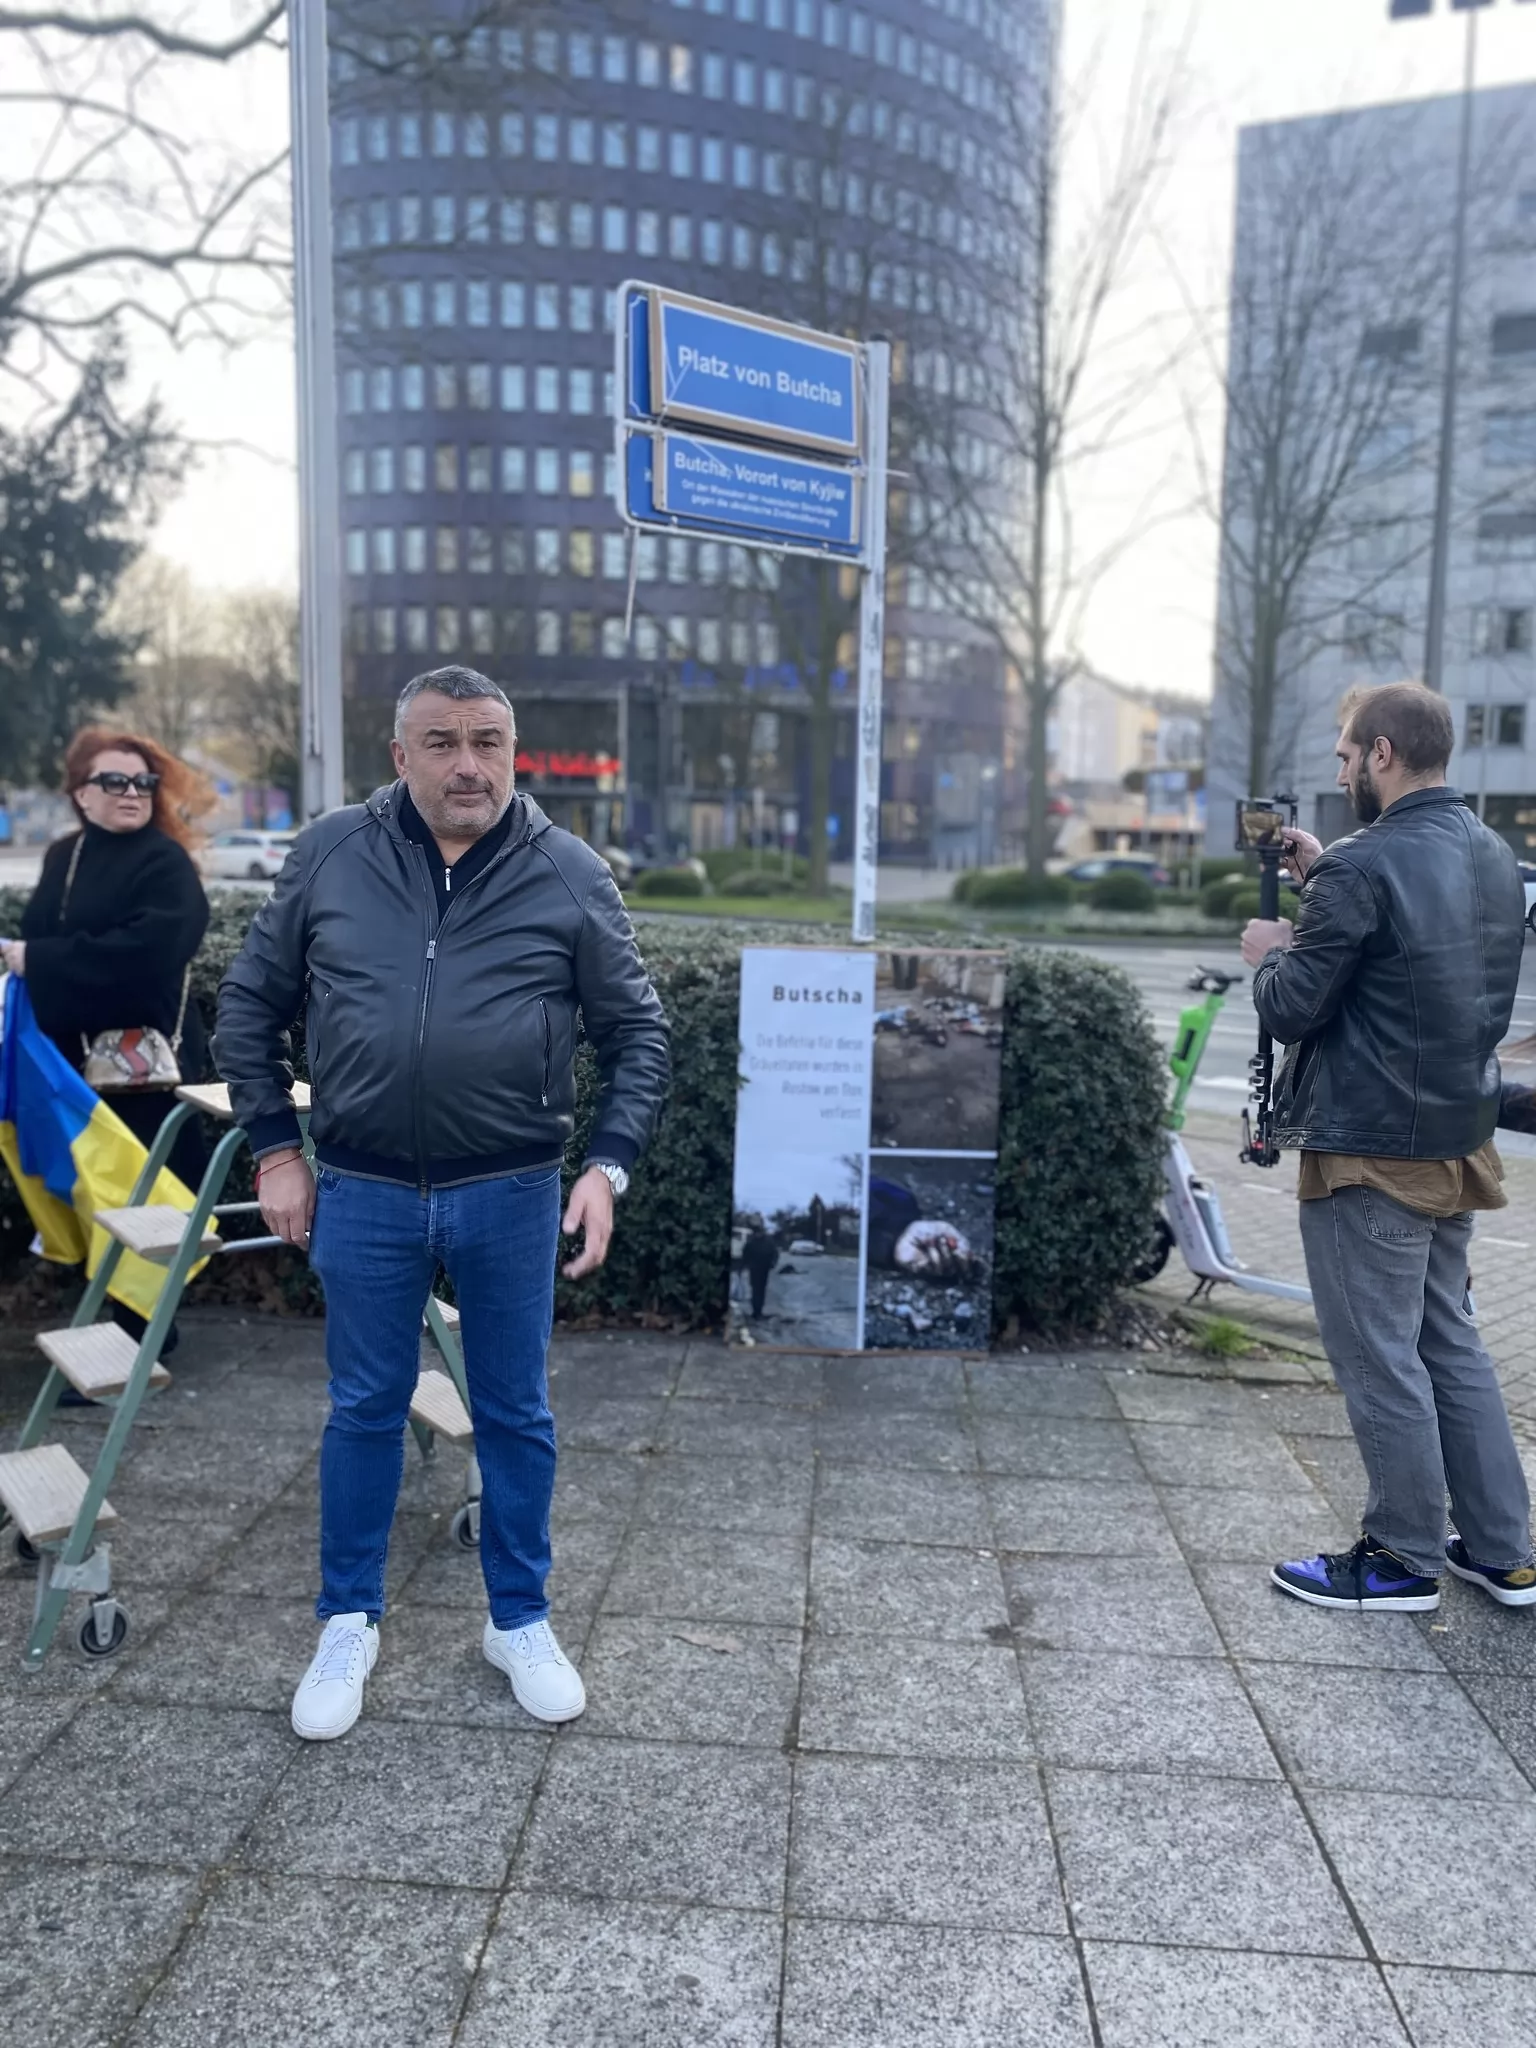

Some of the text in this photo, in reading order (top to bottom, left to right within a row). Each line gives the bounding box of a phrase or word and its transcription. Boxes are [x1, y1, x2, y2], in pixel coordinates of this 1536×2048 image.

[678, 345, 842, 407] Platz von Butcha
[735, 466, 780, 487] Vorort
[782, 475, 807, 493] von
[773, 985, 863, 1004] Butscha
